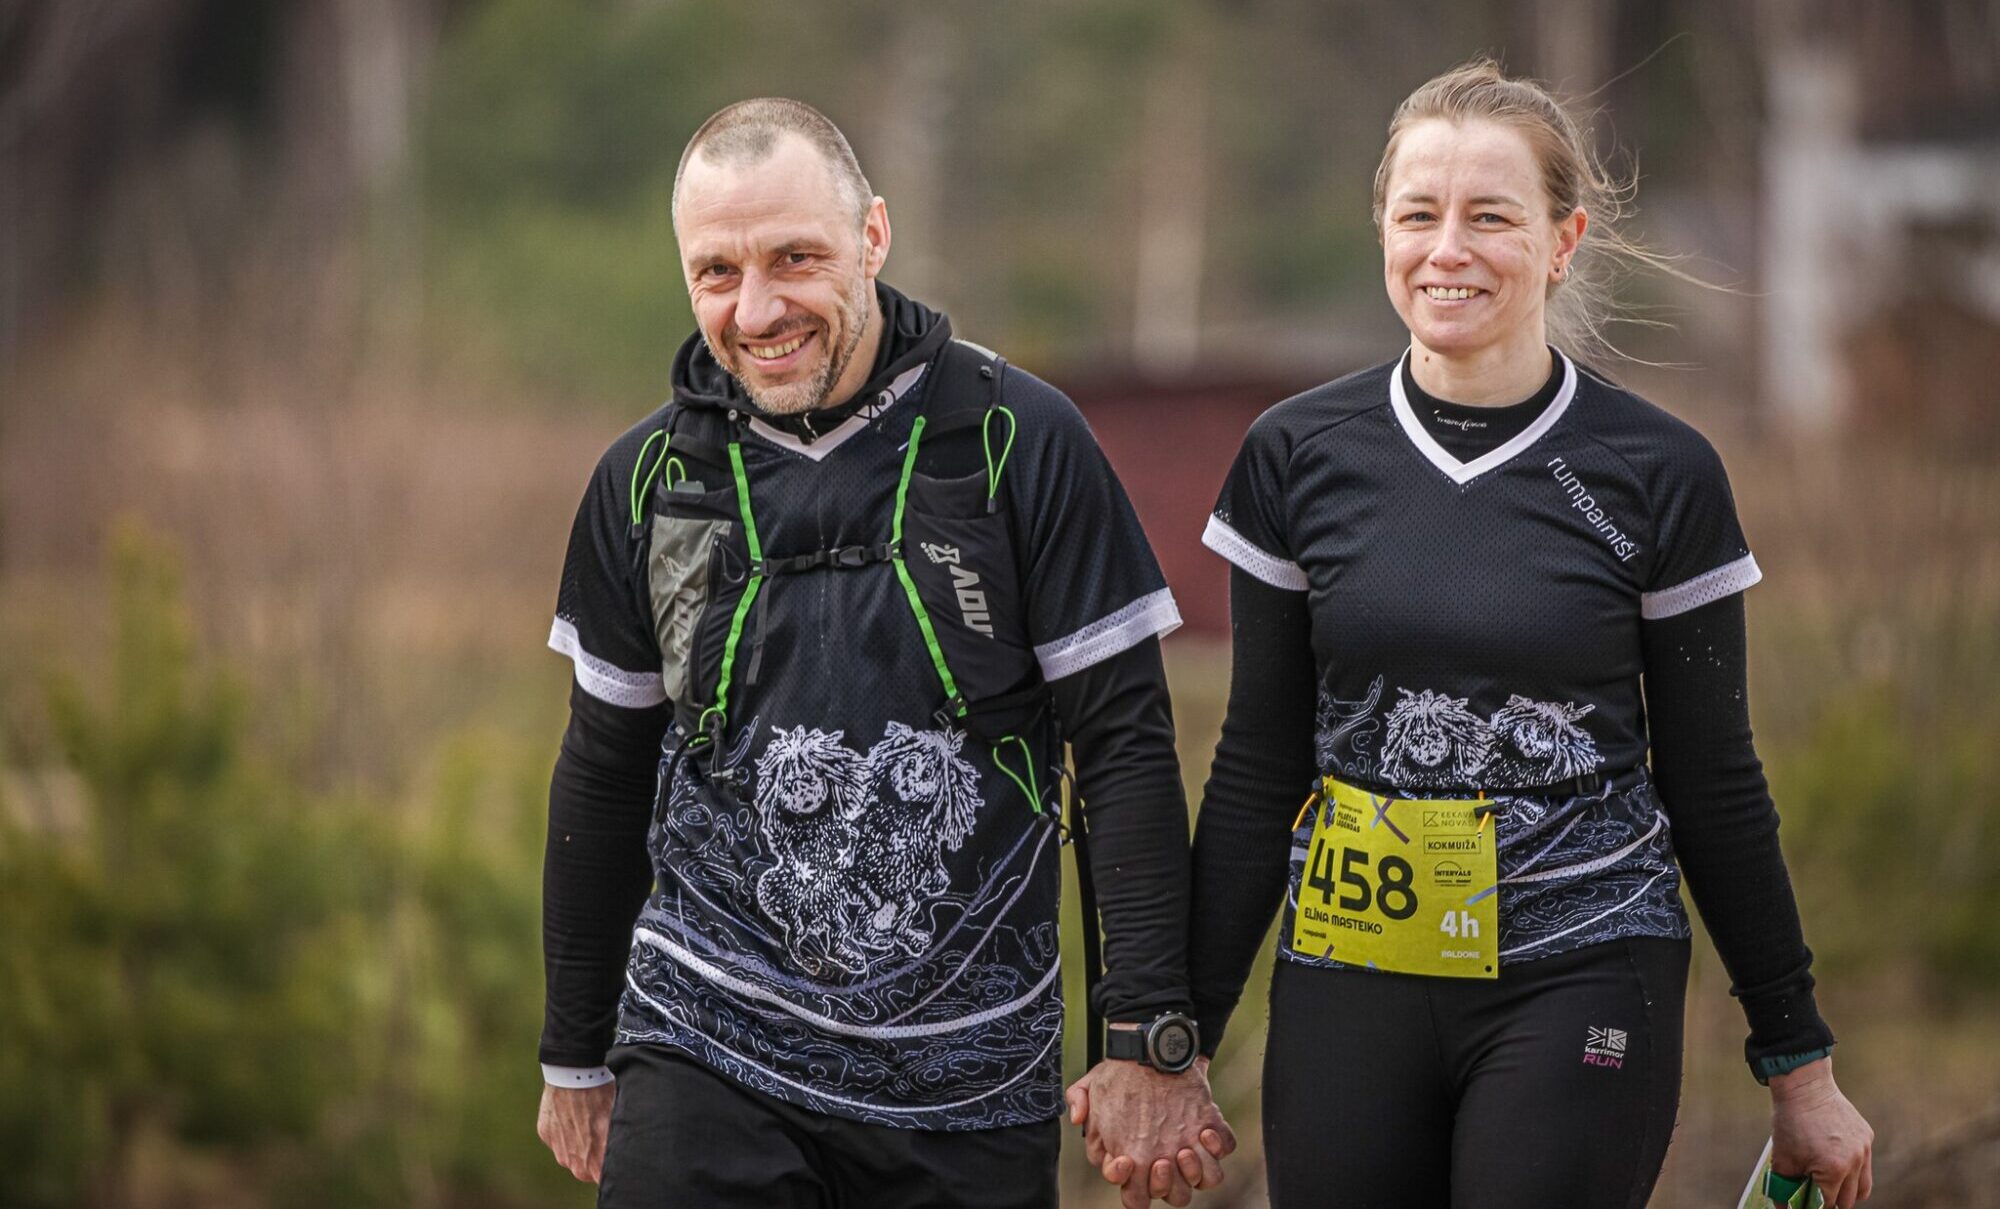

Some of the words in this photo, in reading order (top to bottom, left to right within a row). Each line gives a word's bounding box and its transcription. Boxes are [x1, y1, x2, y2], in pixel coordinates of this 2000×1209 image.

[1427, 839, 1477, 850] KOKMUIŽA
[1308, 838, 1419, 921] 458
[1434, 869, 1472, 877] INTERVALS
[1331, 914, 1383, 935] MASTEIKO
[1440, 910, 1479, 938] 4h
[1585, 1045, 1624, 1059] karrimor
[1583, 1053, 1622, 1069] RUN
